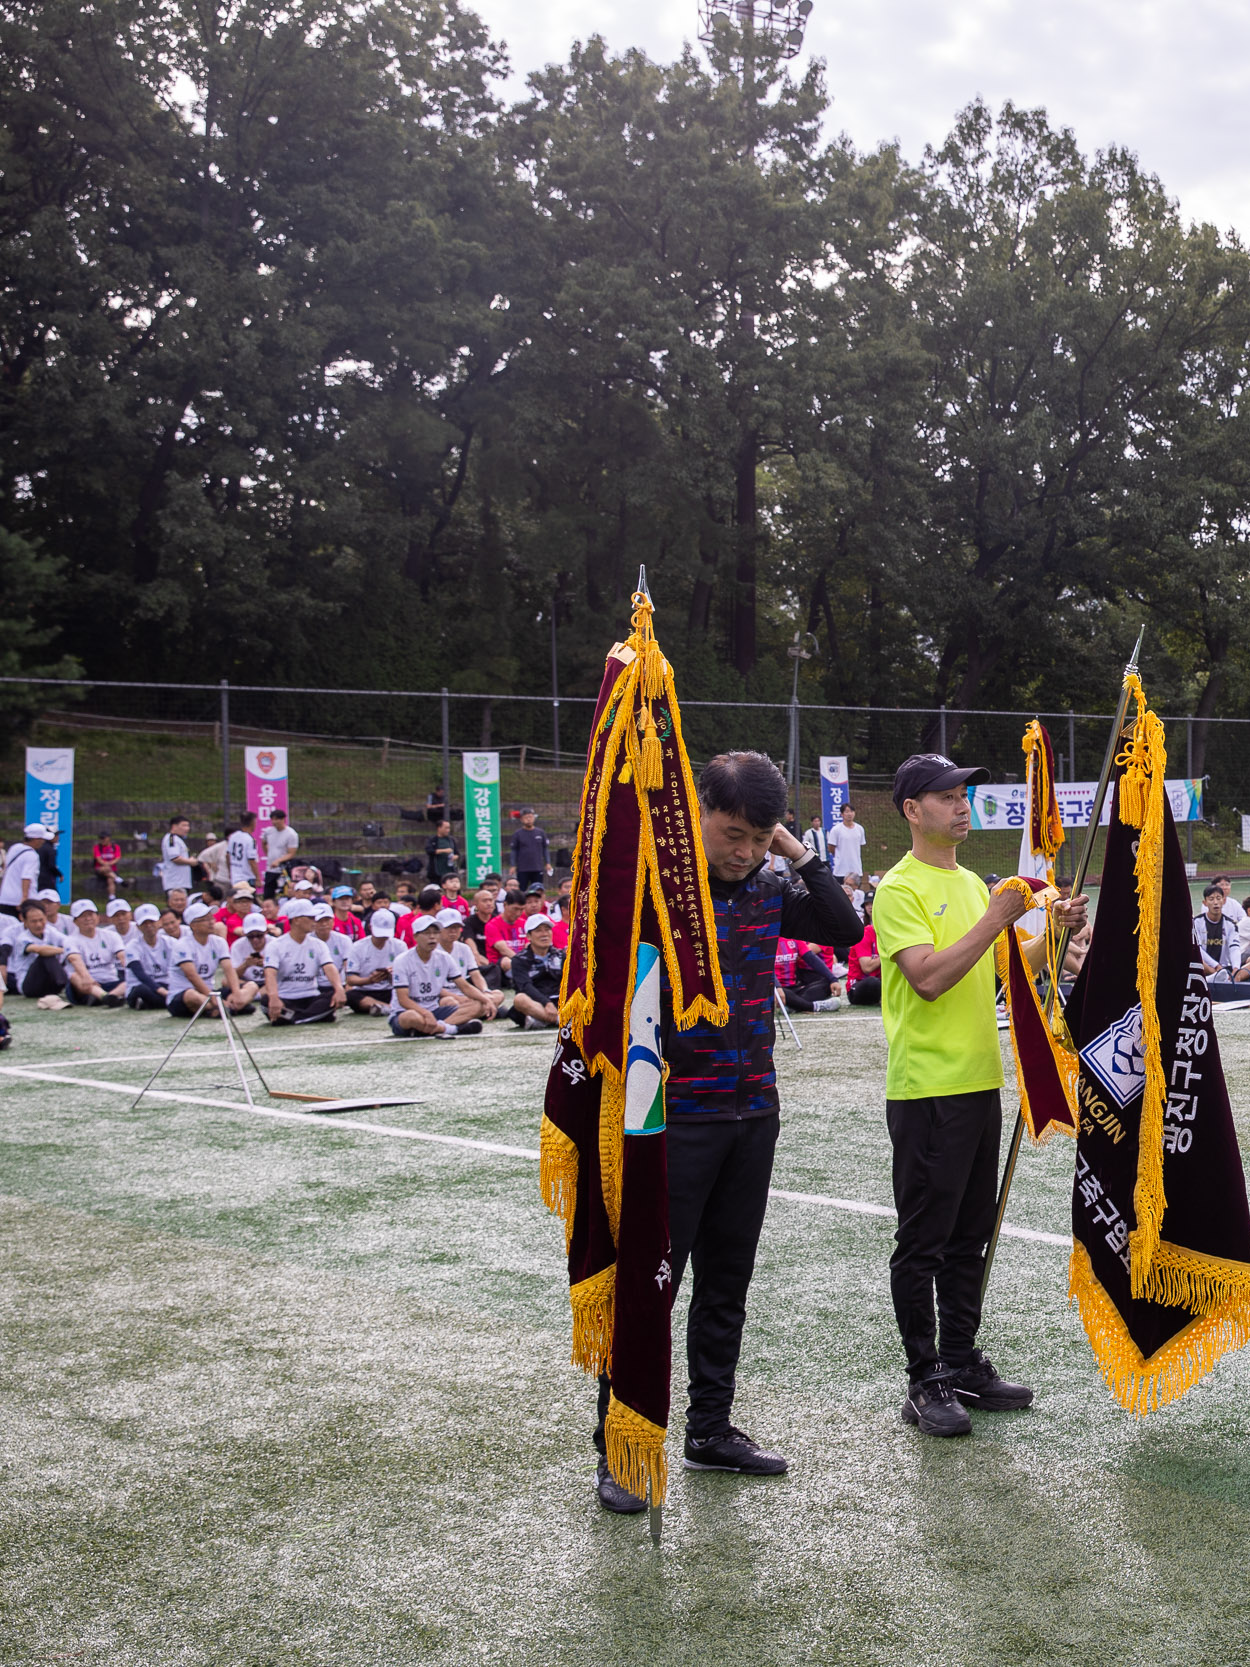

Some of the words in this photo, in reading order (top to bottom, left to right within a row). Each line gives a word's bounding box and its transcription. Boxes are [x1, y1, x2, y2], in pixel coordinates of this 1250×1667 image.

[232, 841, 244, 861] 43
[473, 787, 493, 881] 강변축구회
[419, 982, 432, 994] 38
[1078, 1072, 1127, 1145] ANGJIN
